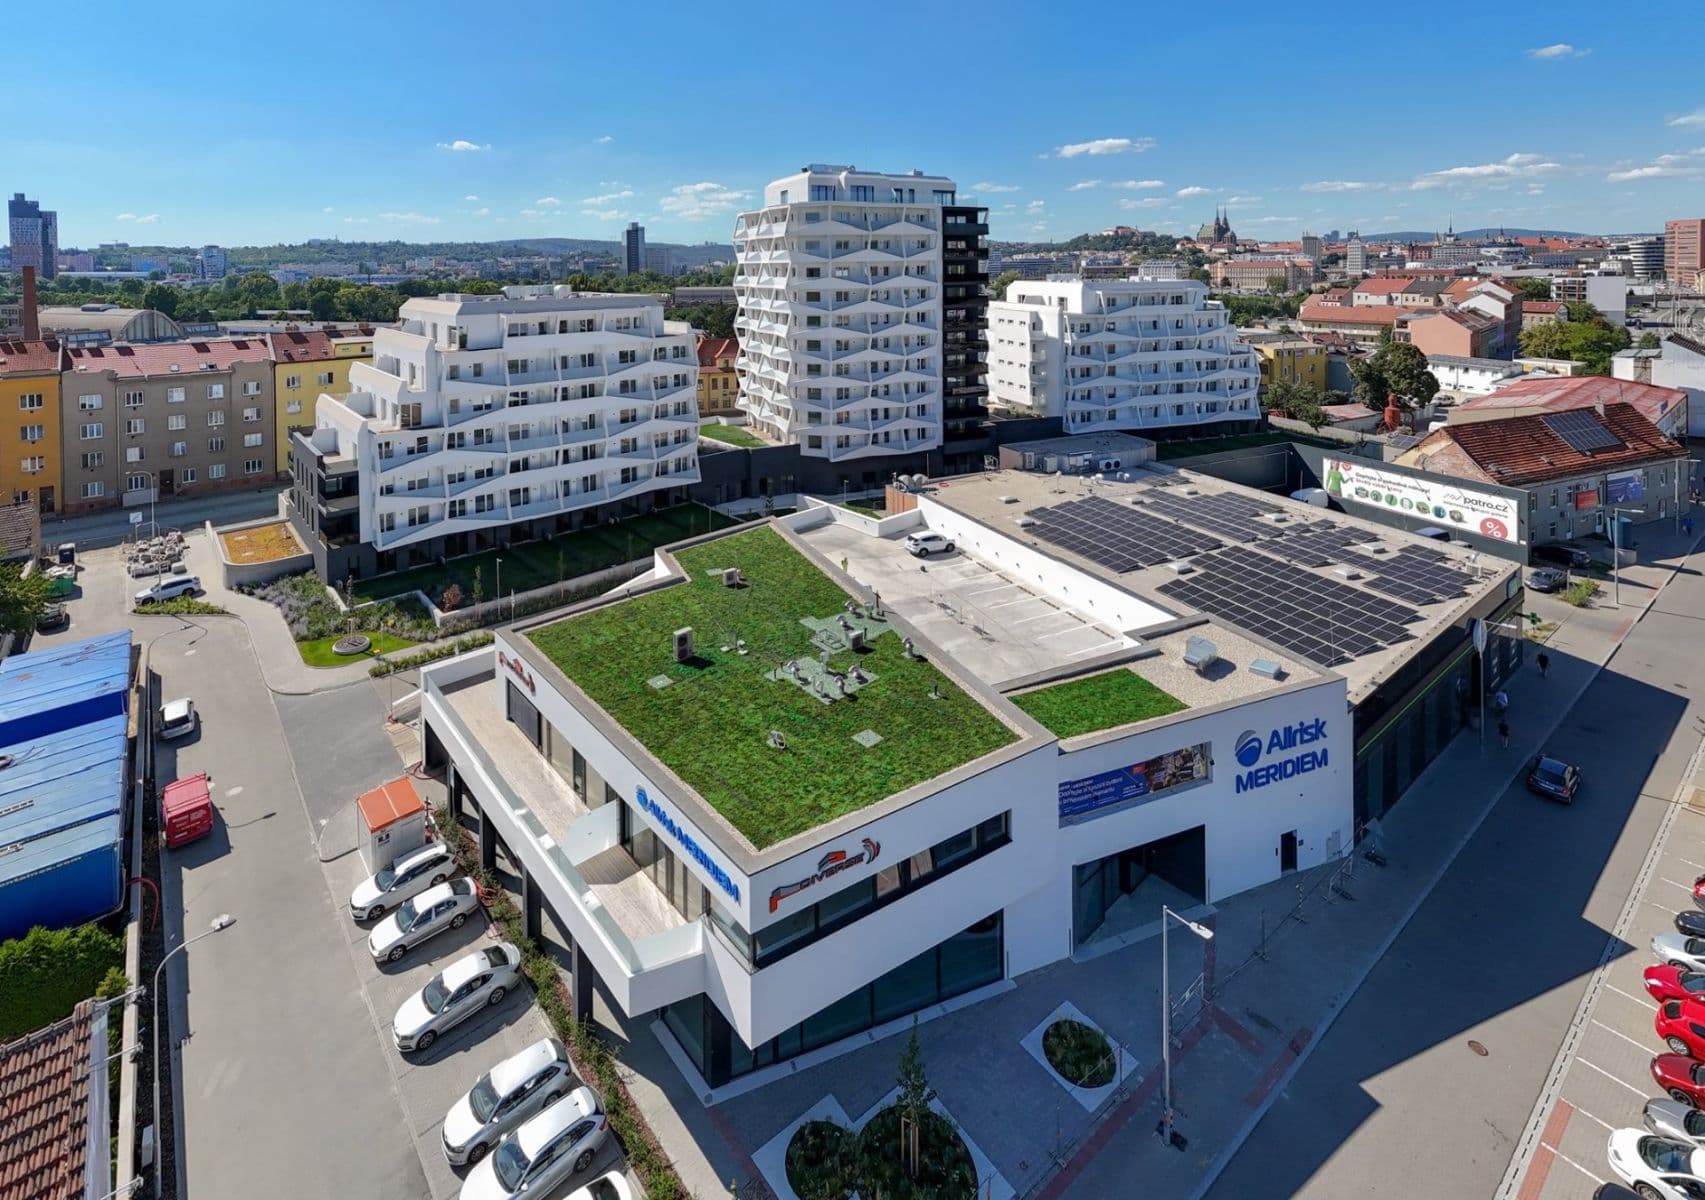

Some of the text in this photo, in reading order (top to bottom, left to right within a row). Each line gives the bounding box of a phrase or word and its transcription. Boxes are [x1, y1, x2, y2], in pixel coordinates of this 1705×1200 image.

[1463, 497, 1509, 513] patro.cz
[1266, 717, 1328, 755] Allrisk
[1235, 748, 1329, 794] MERIDIEM
